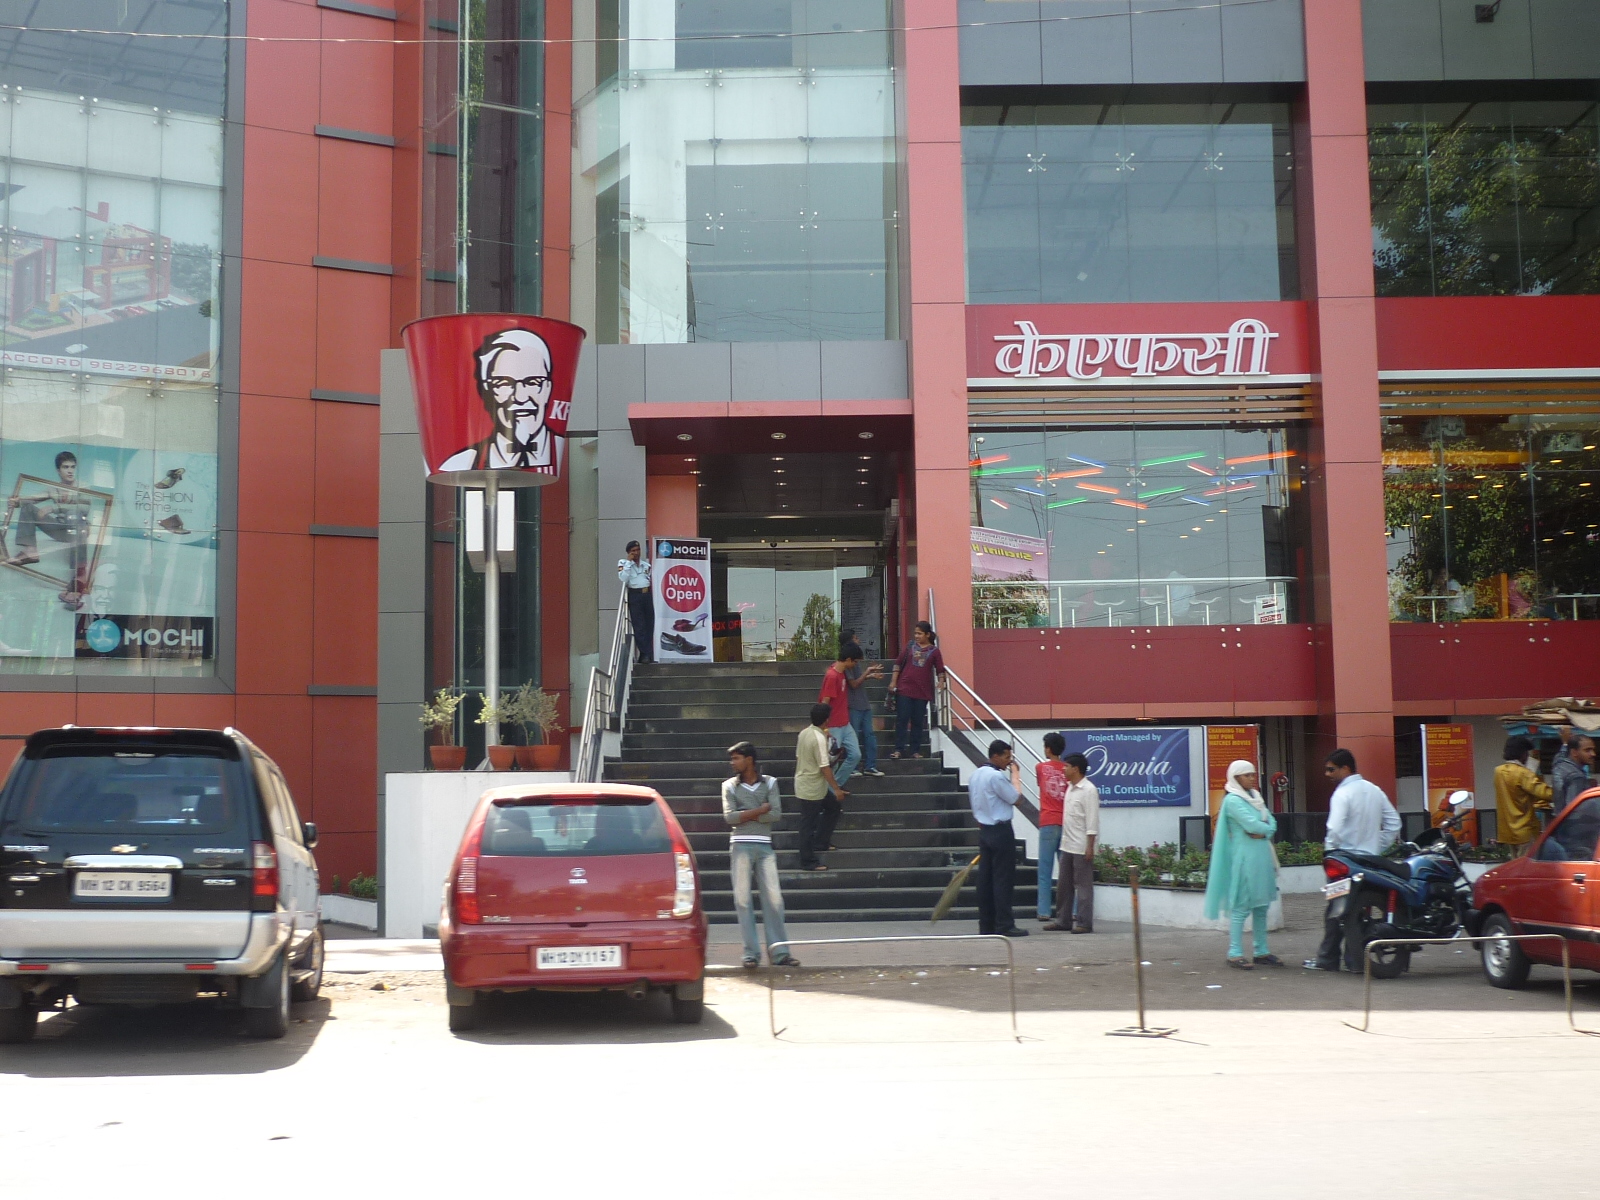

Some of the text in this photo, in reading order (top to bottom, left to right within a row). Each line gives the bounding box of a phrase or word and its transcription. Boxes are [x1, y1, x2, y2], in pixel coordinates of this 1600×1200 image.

[994, 318, 1279, 380] केएफसी
[1, 353, 81, 367] ACCORD
[135, 481, 150, 490] The
[135, 490, 194, 503] FASHION
[135, 501, 171, 513] frame
[673, 546, 706, 555] MOCHI
[668, 574, 699, 586] Now
[666, 587, 702, 602] Open
[123, 628, 204, 647] MOCHI
[1087, 733, 1161, 743] Project Managed by
[1082, 744, 1172, 778] Omnia
[1114, 784, 1177, 794] Consultants
[80, 879, 99, 891] MH
[101, 880, 115, 890] 12
